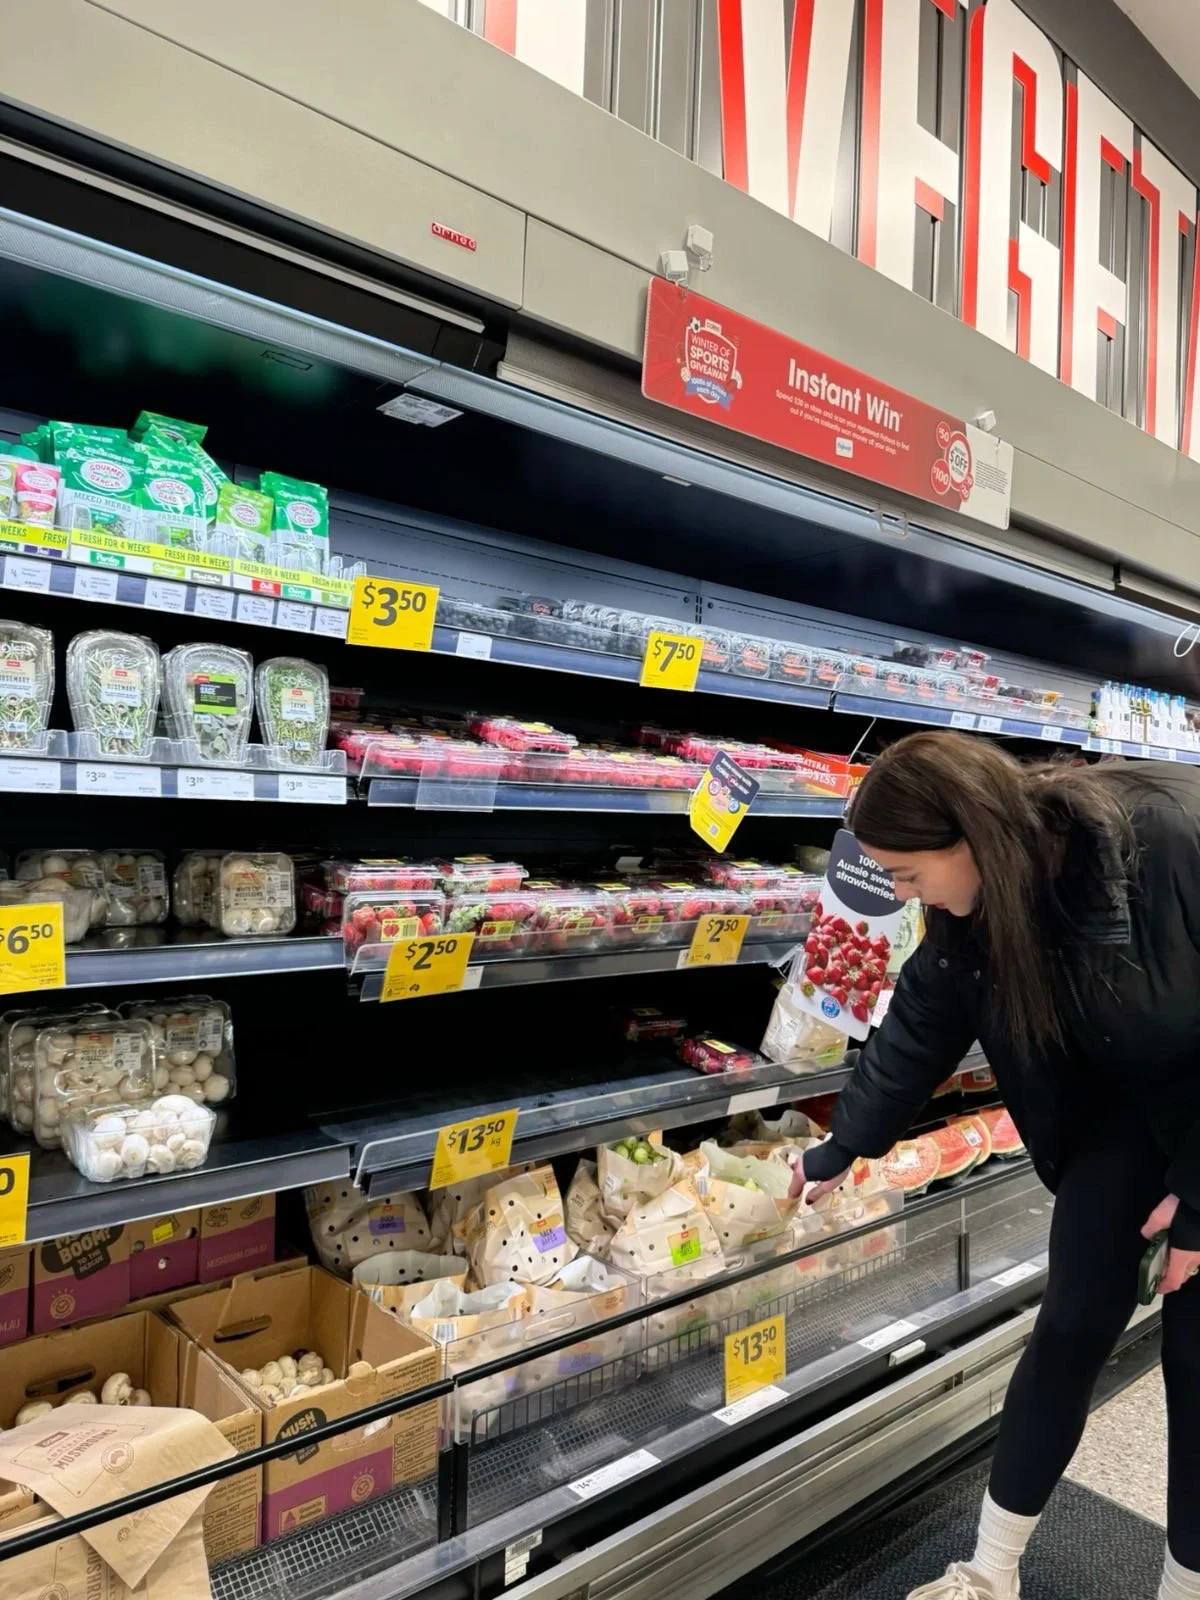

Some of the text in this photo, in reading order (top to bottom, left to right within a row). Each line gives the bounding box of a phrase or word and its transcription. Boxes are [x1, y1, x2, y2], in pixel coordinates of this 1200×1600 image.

[718, 0, 1200, 462] VEGET
[691, 334, 731, 358] WINTER OF
[690, 345, 730, 372] SPORTS
[690, 360, 728, 382] GIVEAWAY
[775, 389, 794, 403] Spend
[788, 357, 900, 433] Instant Win
[89, 463, 127, 479] GOURMET
[73, 491, 103, 505] MIXED
[42, 531, 68, 546] FRESH
[79, 532, 151, 554] FRESH FOR 4 WEEKS
[164, 548, 231, 569] FRESH FOR 4 WEEKS
[239, 561, 260, 573] FRESH
[261, 565, 274, 577] FOR
[279, 569, 301, 581] WEEKS
[836, 858, 895, 890] Aussie swee
[835, 871, 896, 901] strawberries
[490, 1136, 502, 1148] kg
[281, 1410, 317, 1440] MUSH
[53, 1428, 119, 1471] MUSHROOMS
